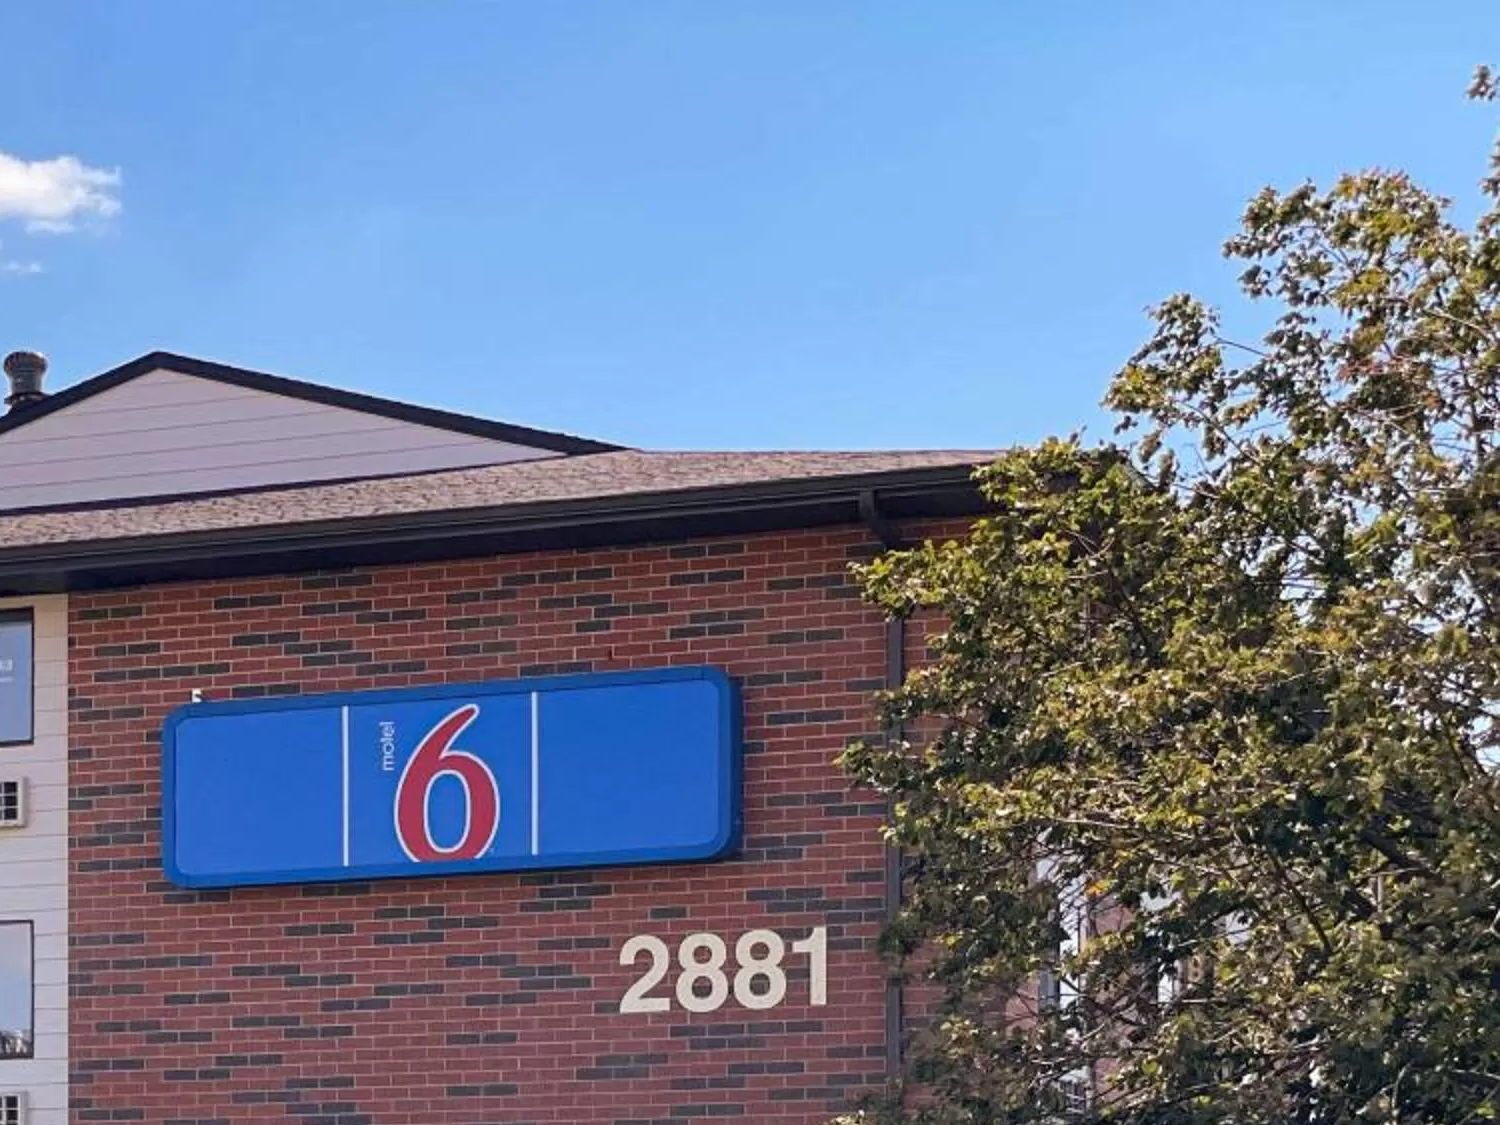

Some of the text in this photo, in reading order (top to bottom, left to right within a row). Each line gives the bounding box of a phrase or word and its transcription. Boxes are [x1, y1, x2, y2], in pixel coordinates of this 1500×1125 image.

[379, 721, 395, 771] motel
[393, 703, 501, 863] 6
[619, 926, 827, 1014] 2881
